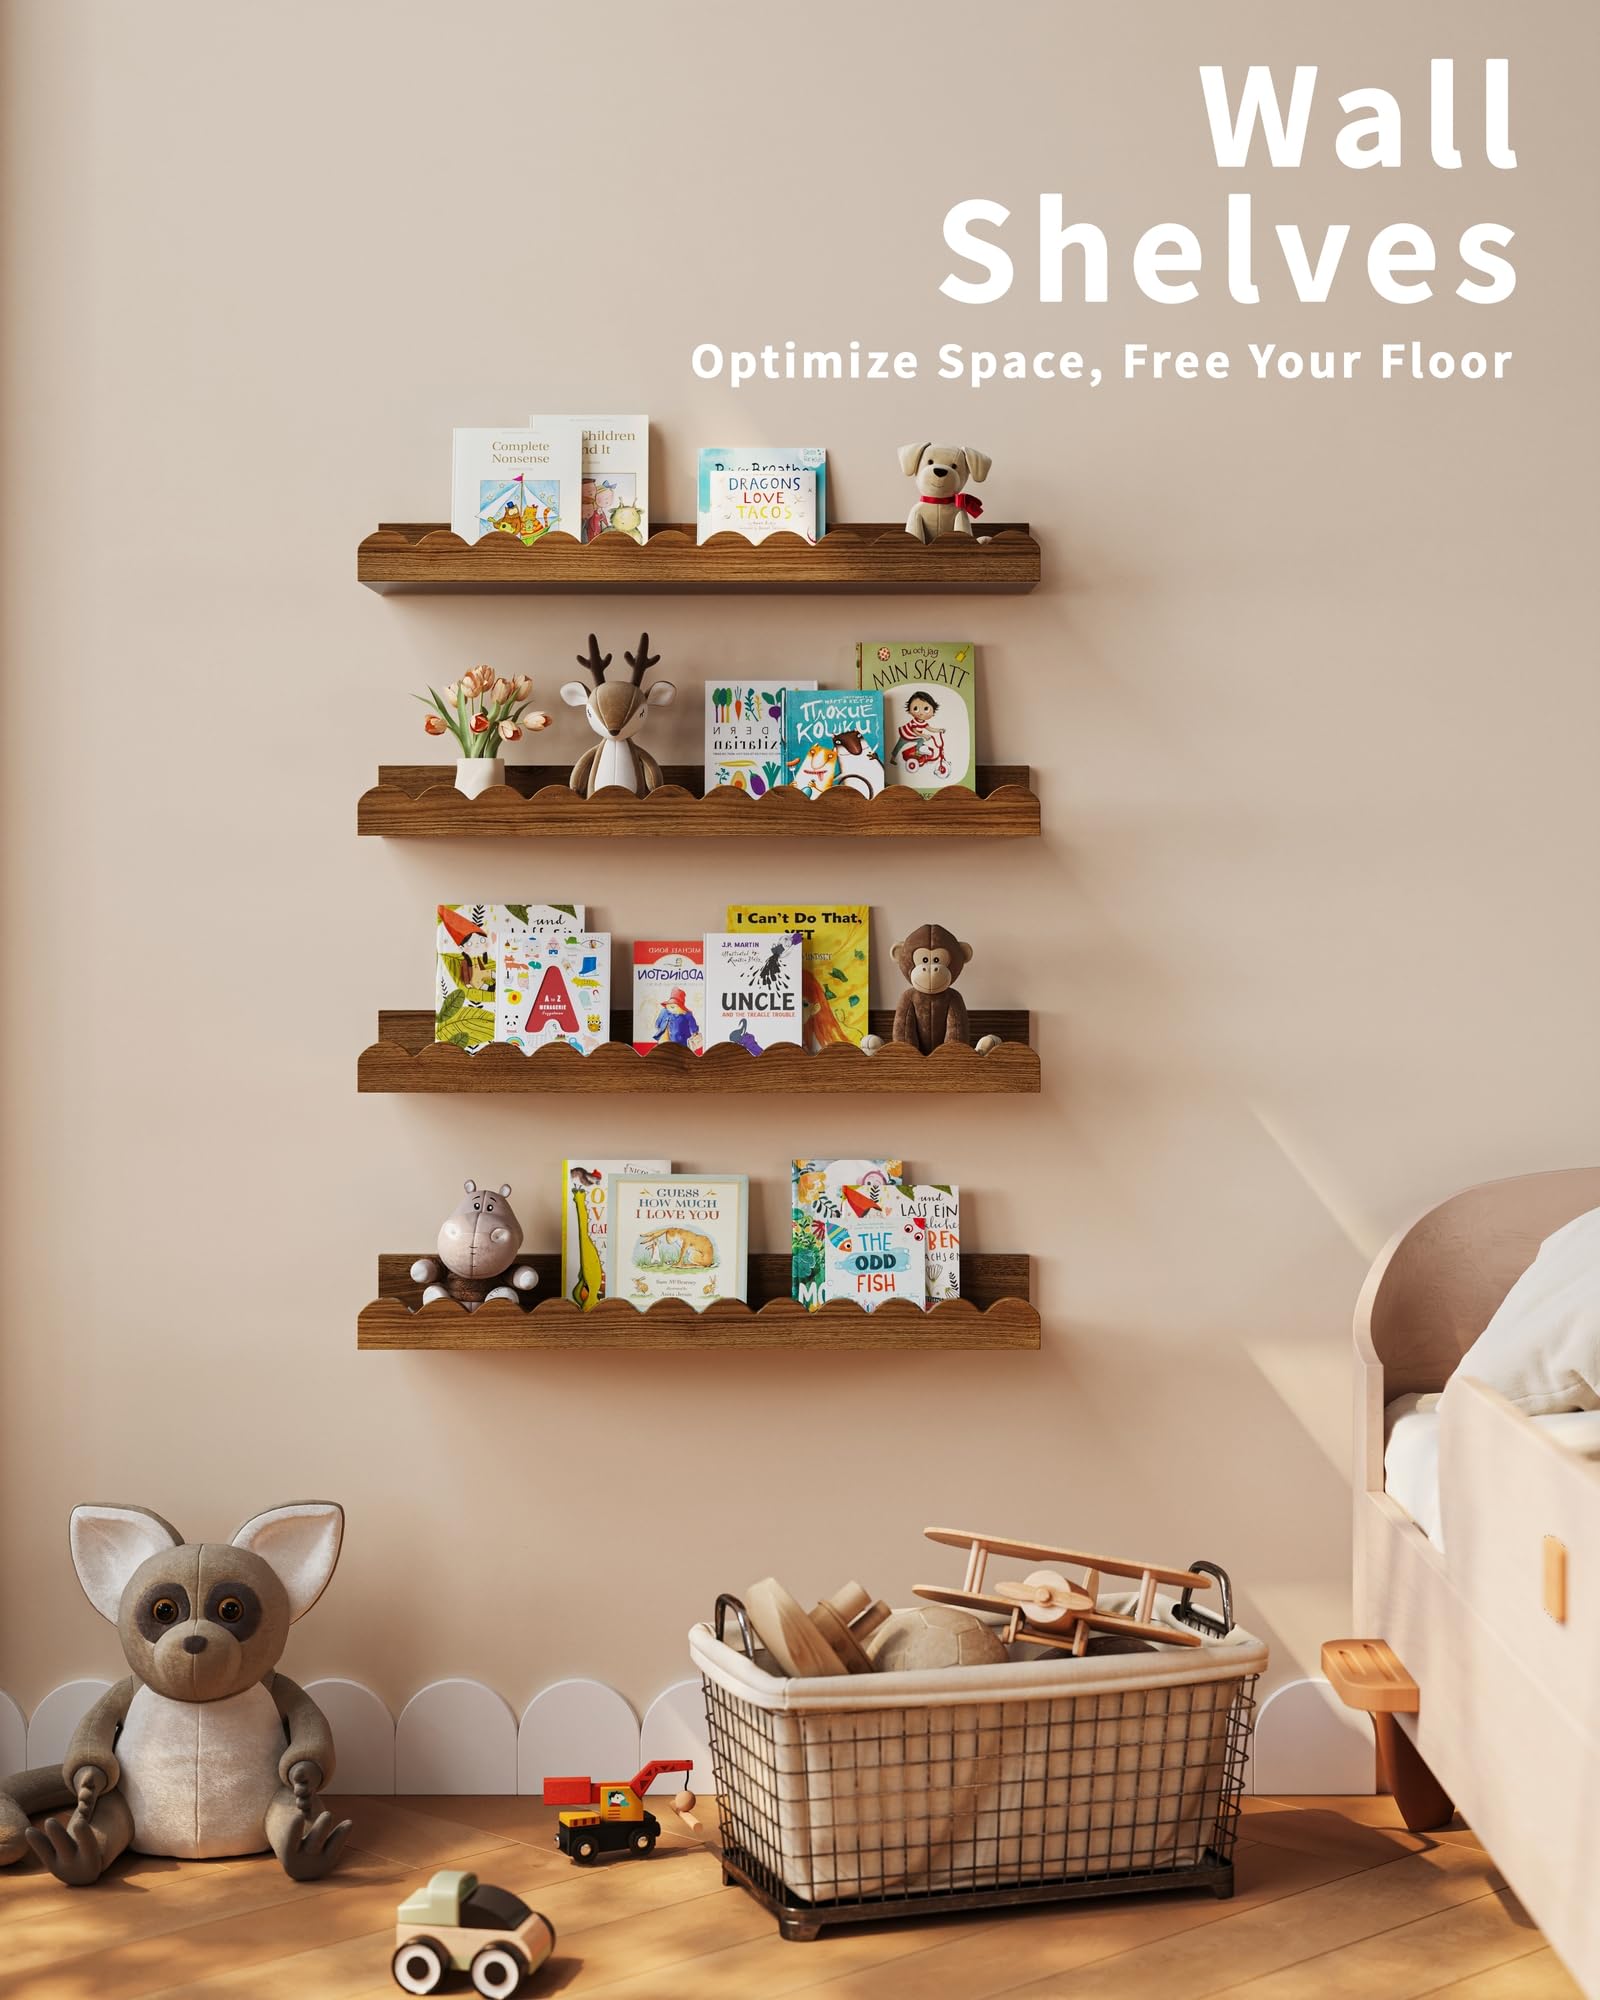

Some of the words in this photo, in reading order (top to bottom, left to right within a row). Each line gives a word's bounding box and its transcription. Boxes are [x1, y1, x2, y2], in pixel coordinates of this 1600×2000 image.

[492, 441, 550, 453] Complete
[602, 444, 611, 454] It
[492, 454, 550, 463] Nonsense
[729, 477, 800, 491] DRAGONS
[744, 492, 784, 504] LOVE
[736, 505, 792, 519] TACOS
[901, 648, 912, 657] Du
[923, 648, 939, 659] jag
[872, 661, 908, 690] MIN
[913, 659, 970, 688] SKATT
[534, 914, 566, 926] und
[737, 913, 742, 923] I
[748, 913, 790, 924] Can't
[795, 913, 817, 923] Do
[821, 913, 863, 925] That,
[721, 992, 795, 1011] UNCLE
[656, 1188, 700, 1198] GUESS
[639, 1199, 671, 1208] HOW
[675, 1199, 718, 1209] MUCH
[635, 1209, 641, 1219] I
[646, 1209, 685, 1220] LOVE
[688, 1209, 720, 1220] YOU
[900, 1203, 928, 1218] LASS
[858, 1232, 892, 1252] THE
[855, 1253, 896, 1271] ODD
[857, 1273, 896, 1293] FISH
